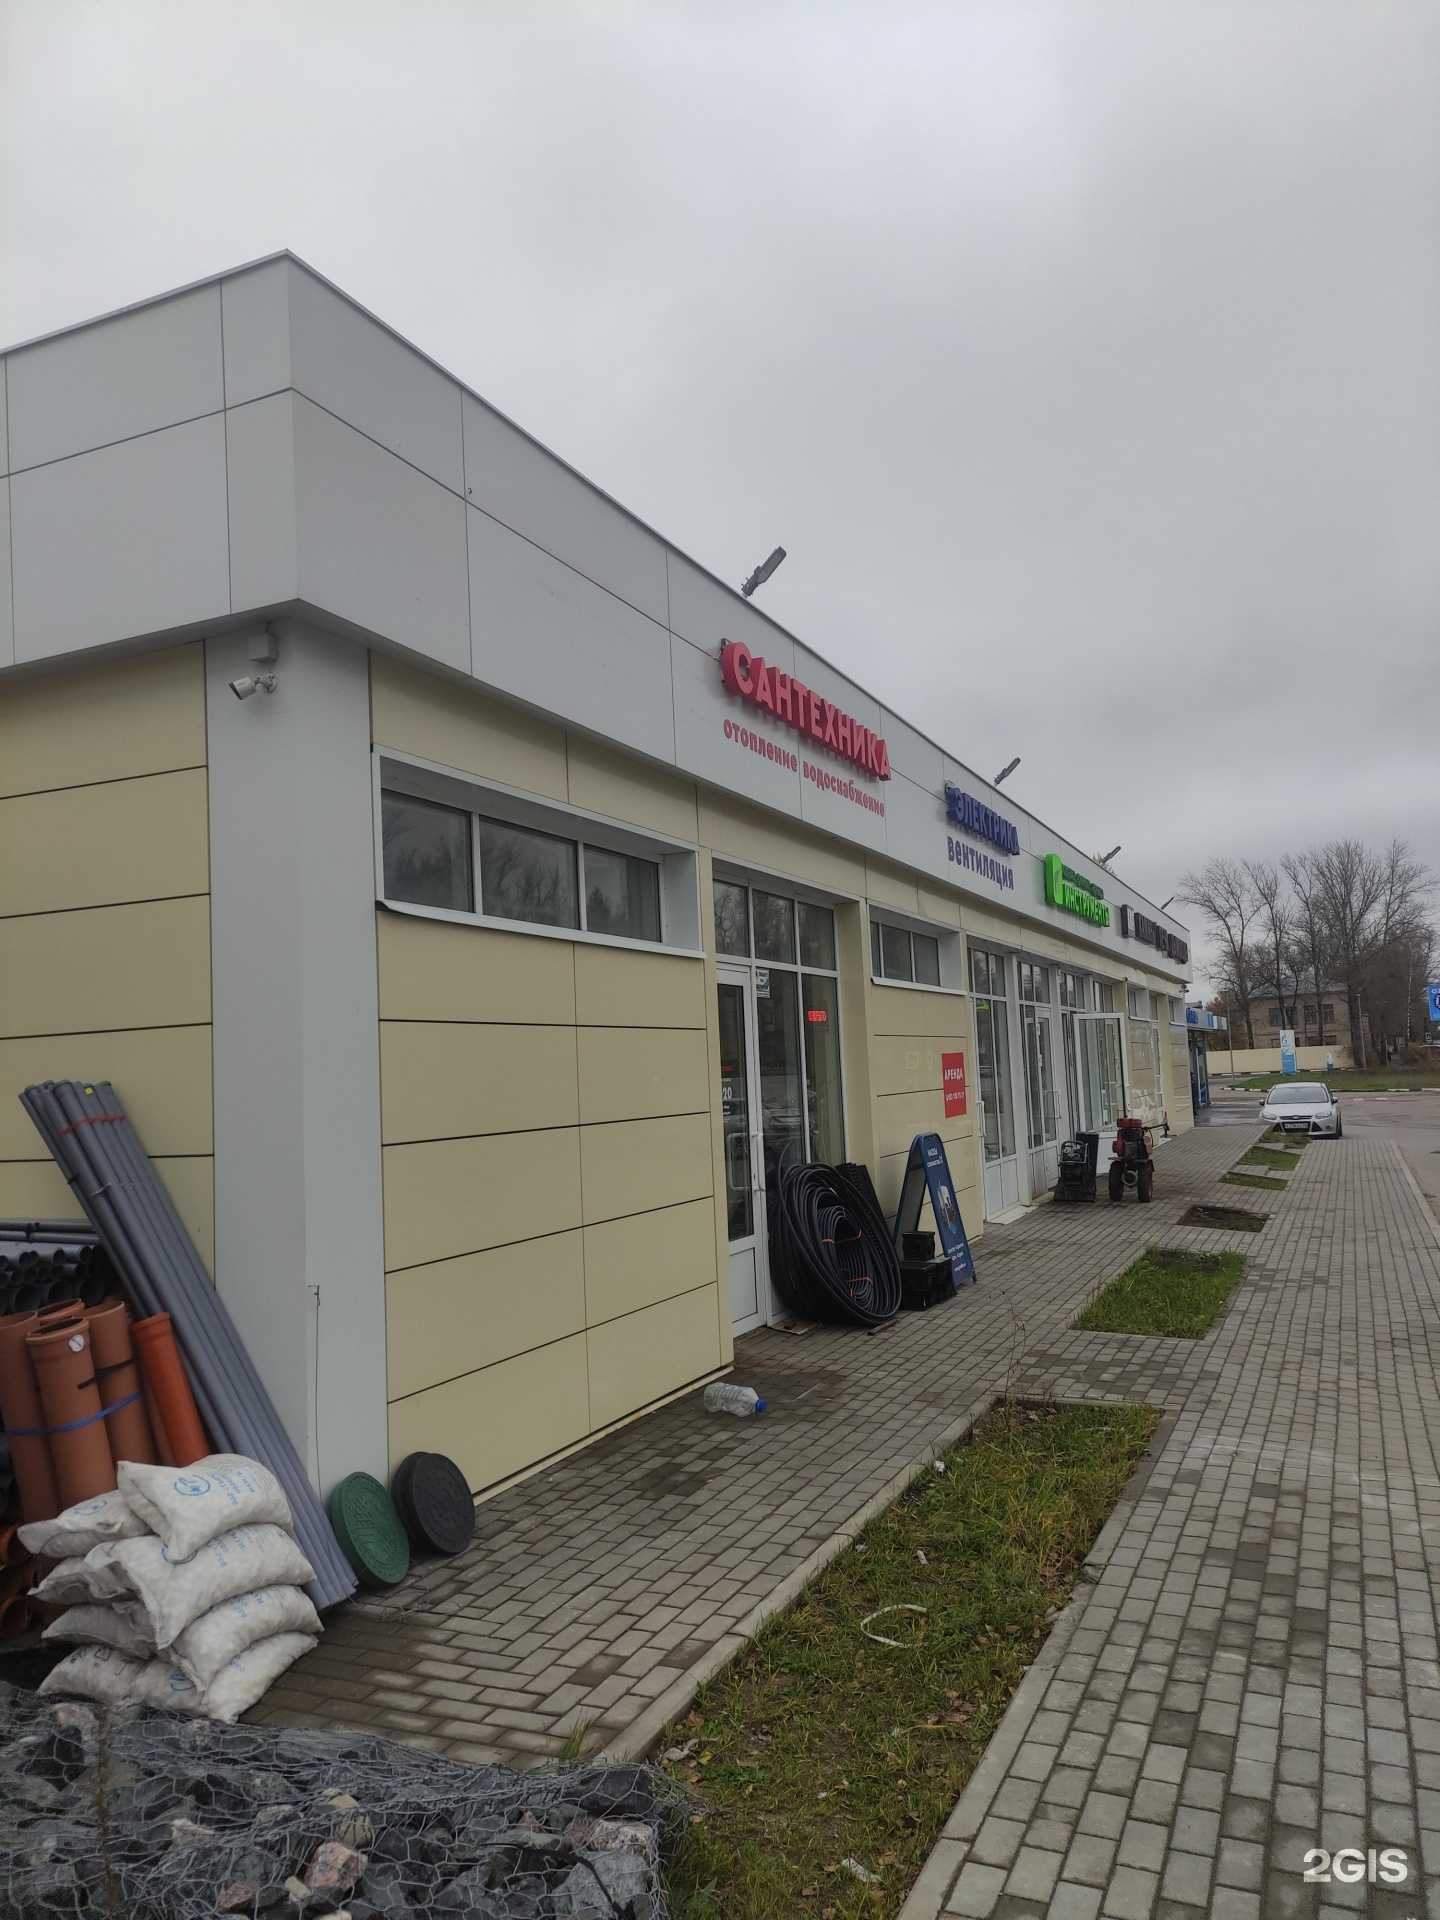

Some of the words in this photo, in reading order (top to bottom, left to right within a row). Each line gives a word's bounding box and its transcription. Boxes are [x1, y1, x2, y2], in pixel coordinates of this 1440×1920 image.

[720, 641, 891, 780] САНТЕХНИКА
[723, 718, 798, 773] отопление
[803, 760, 885, 817] водоснабжение
[945, 786, 1020, 856] ЭЛЕКТРИКА
